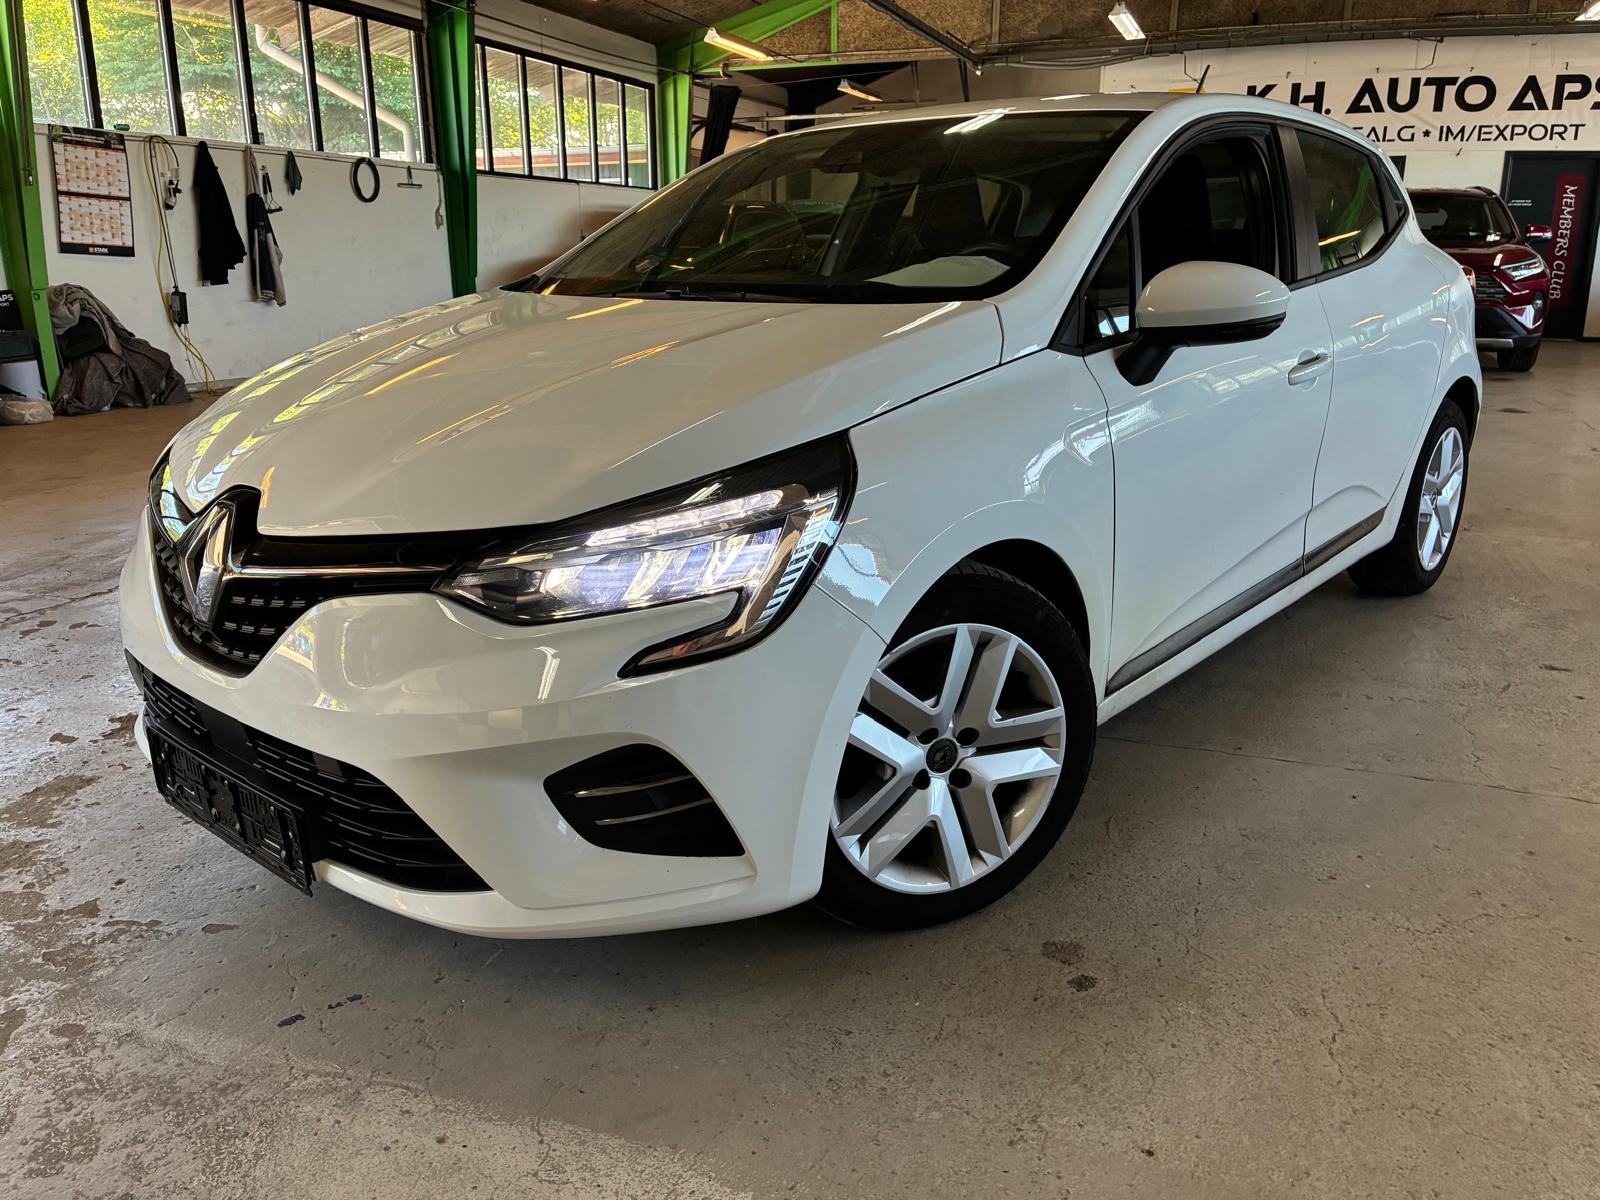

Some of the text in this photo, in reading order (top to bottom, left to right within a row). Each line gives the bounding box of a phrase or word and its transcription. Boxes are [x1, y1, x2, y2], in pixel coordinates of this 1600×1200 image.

[1345, 75, 1497, 114] AUTO
[1352, 123, 1586, 143] ALG IM/EXPORT
[1548, 185, 1578, 300] MEMBERS CLUB
